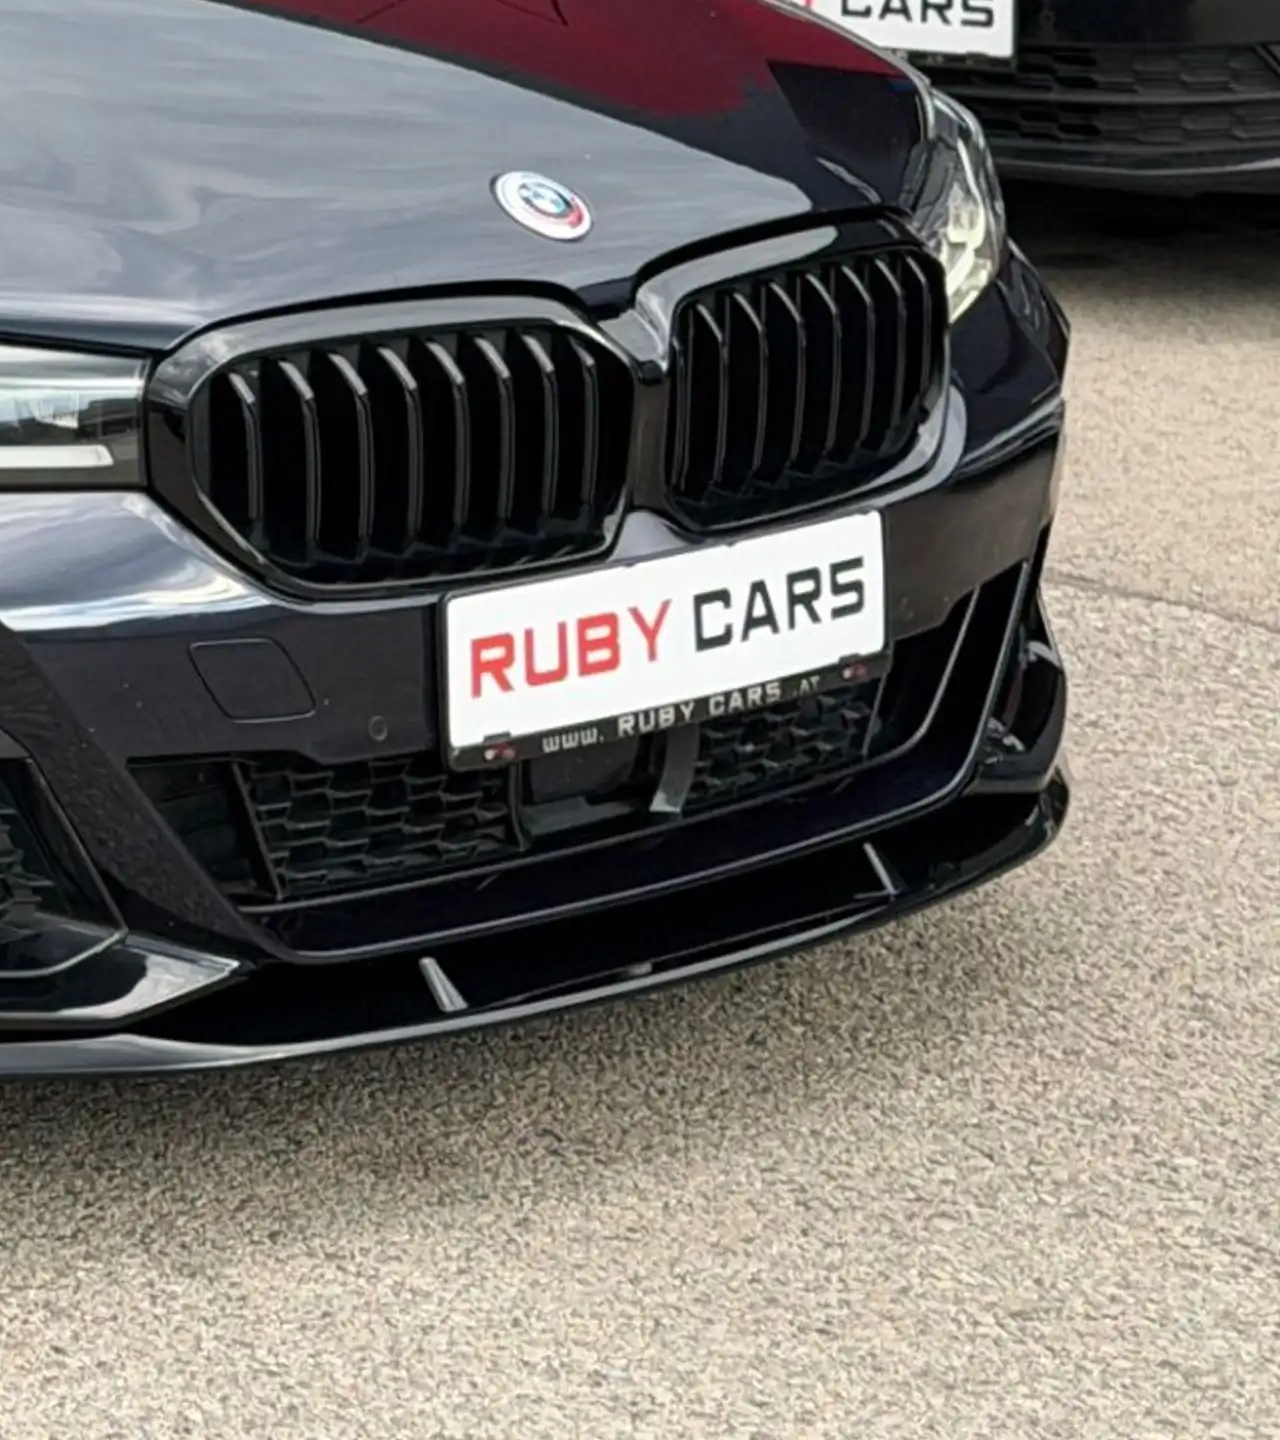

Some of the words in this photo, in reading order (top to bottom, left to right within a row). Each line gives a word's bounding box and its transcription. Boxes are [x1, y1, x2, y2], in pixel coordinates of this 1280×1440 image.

[470, 597, 674, 699] RUBY
[692, 555, 865, 653] CARS
[617, 701, 696, 738] RUBY
[708, 681, 782, 716] CARS
